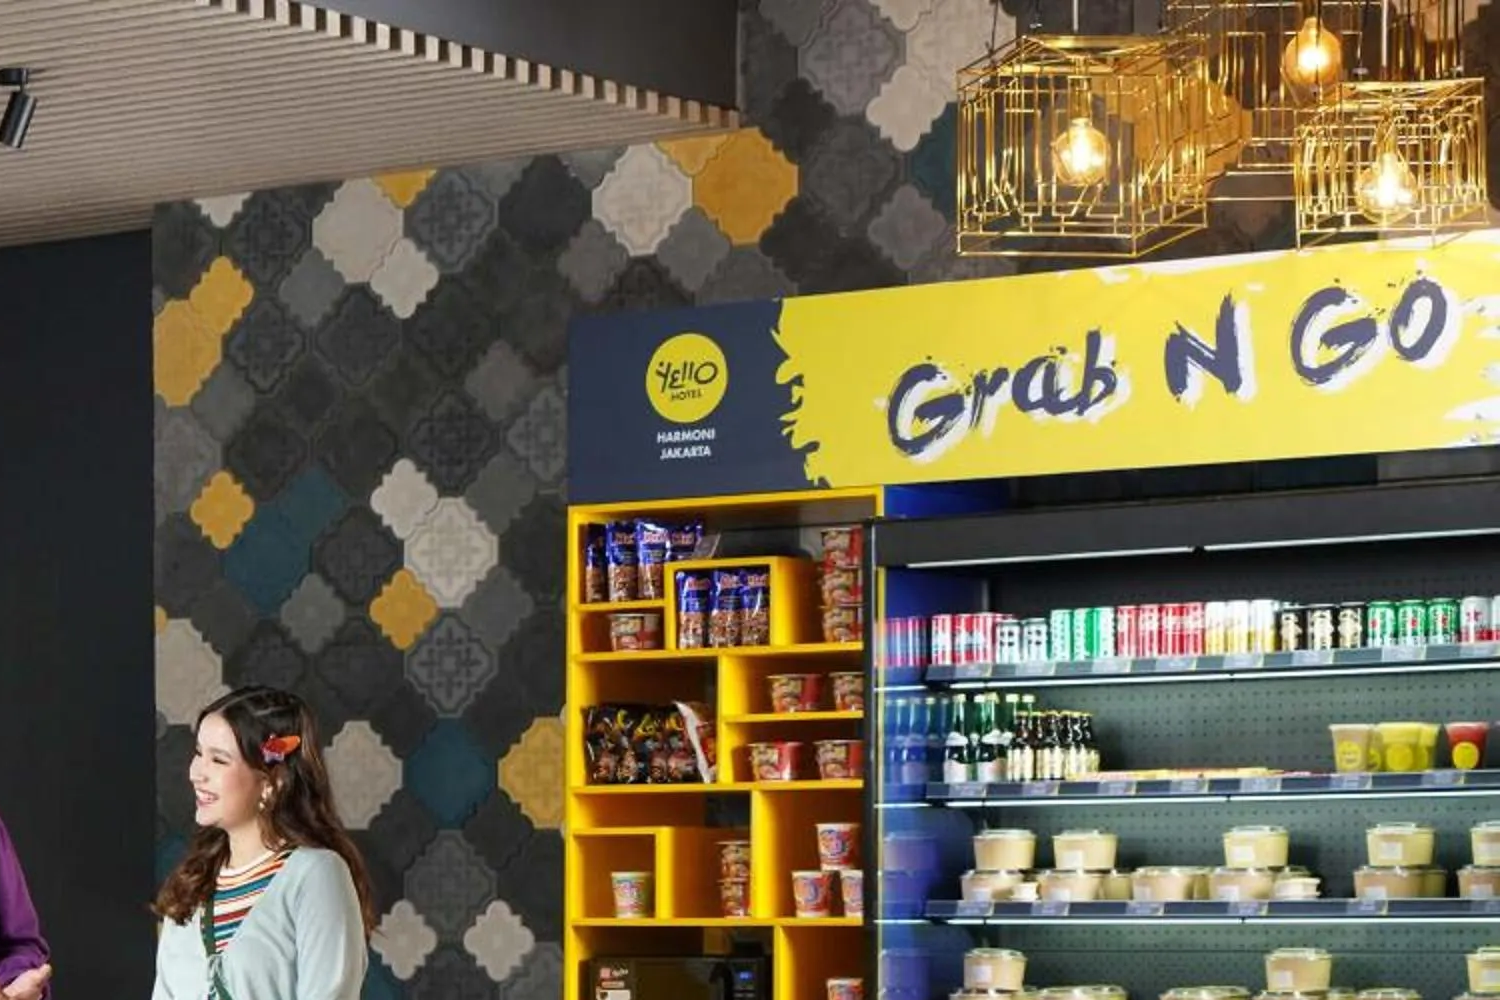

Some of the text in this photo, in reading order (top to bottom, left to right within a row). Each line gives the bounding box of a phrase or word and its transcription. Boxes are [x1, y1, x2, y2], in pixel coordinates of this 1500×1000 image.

[887, 326, 1119, 458] Grab
[1164, 293, 1244, 403] N
[671, 389, 702, 401] HOTEL
[657, 428, 715, 443] HARMONI
[660, 446, 711, 460] JAKARTA
